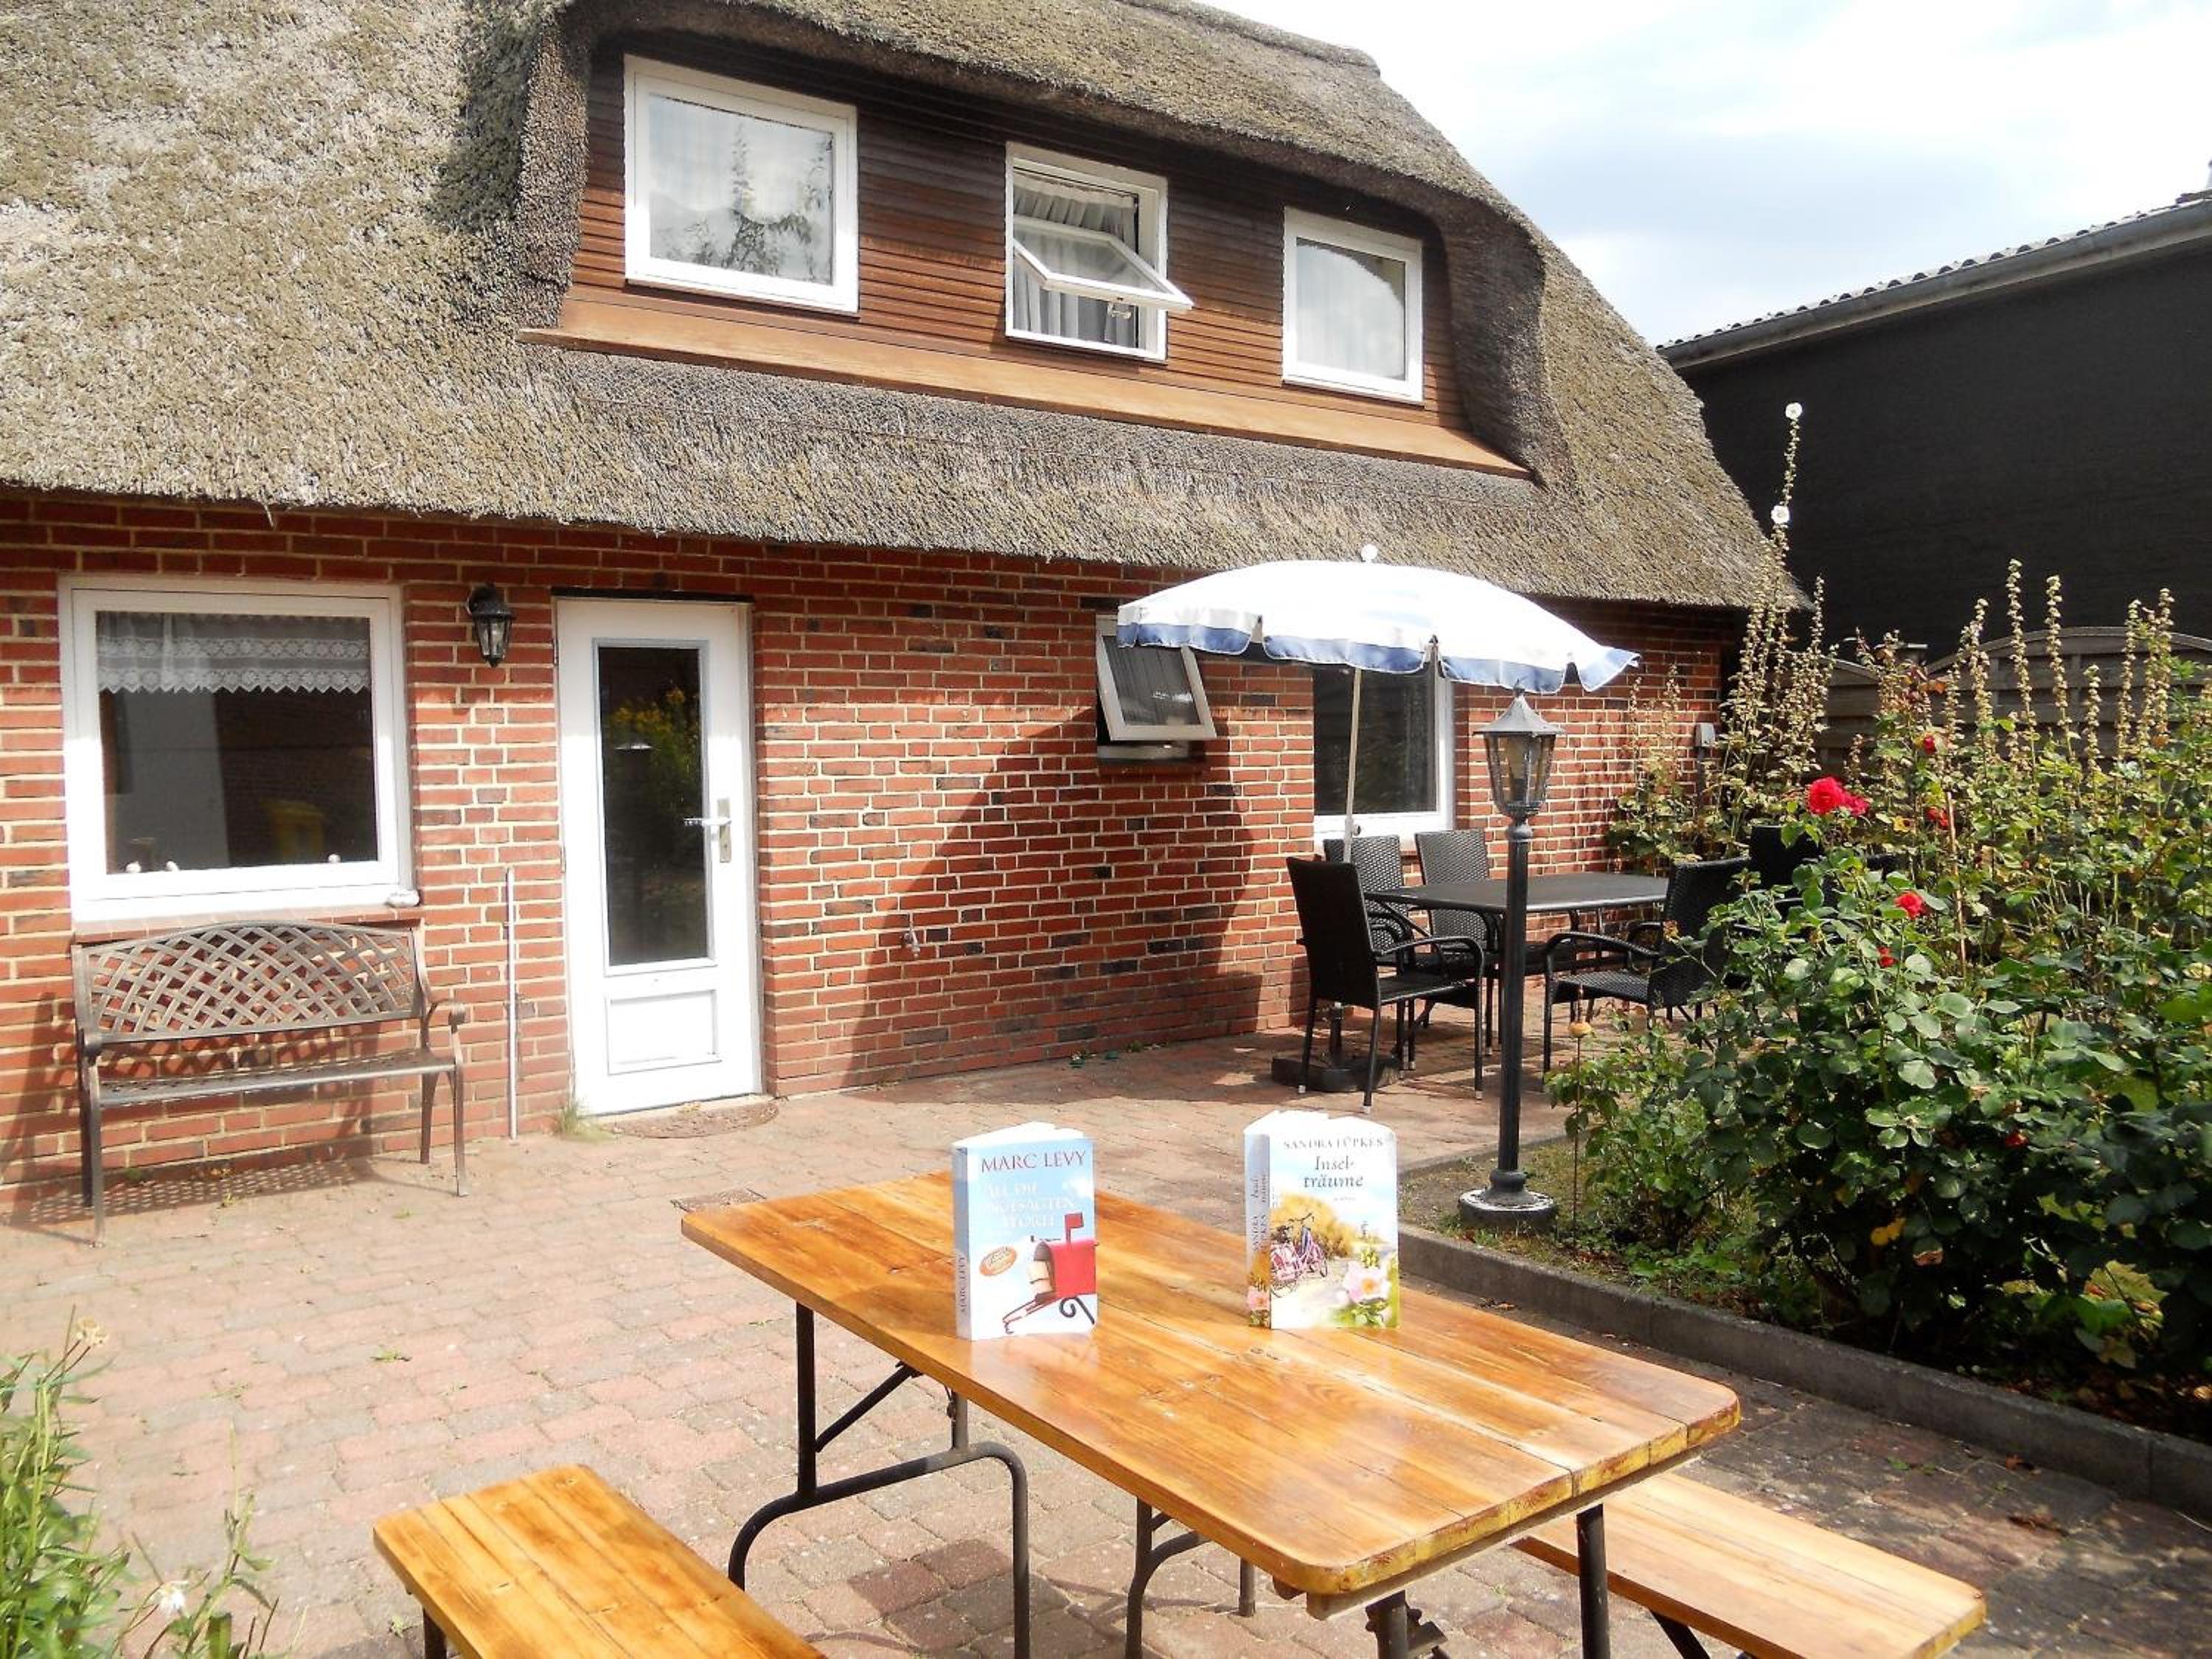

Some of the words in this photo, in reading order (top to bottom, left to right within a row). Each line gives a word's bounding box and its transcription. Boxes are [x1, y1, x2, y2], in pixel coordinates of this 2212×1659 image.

[1283, 1138, 1332, 1150] SANDRA
[981, 1153, 1037, 1173] MARC
[1045, 1150, 1086, 1167] LEVY
[1315, 1155, 1355, 1171] Insel-
[1304, 1173, 1363, 1189] träume
